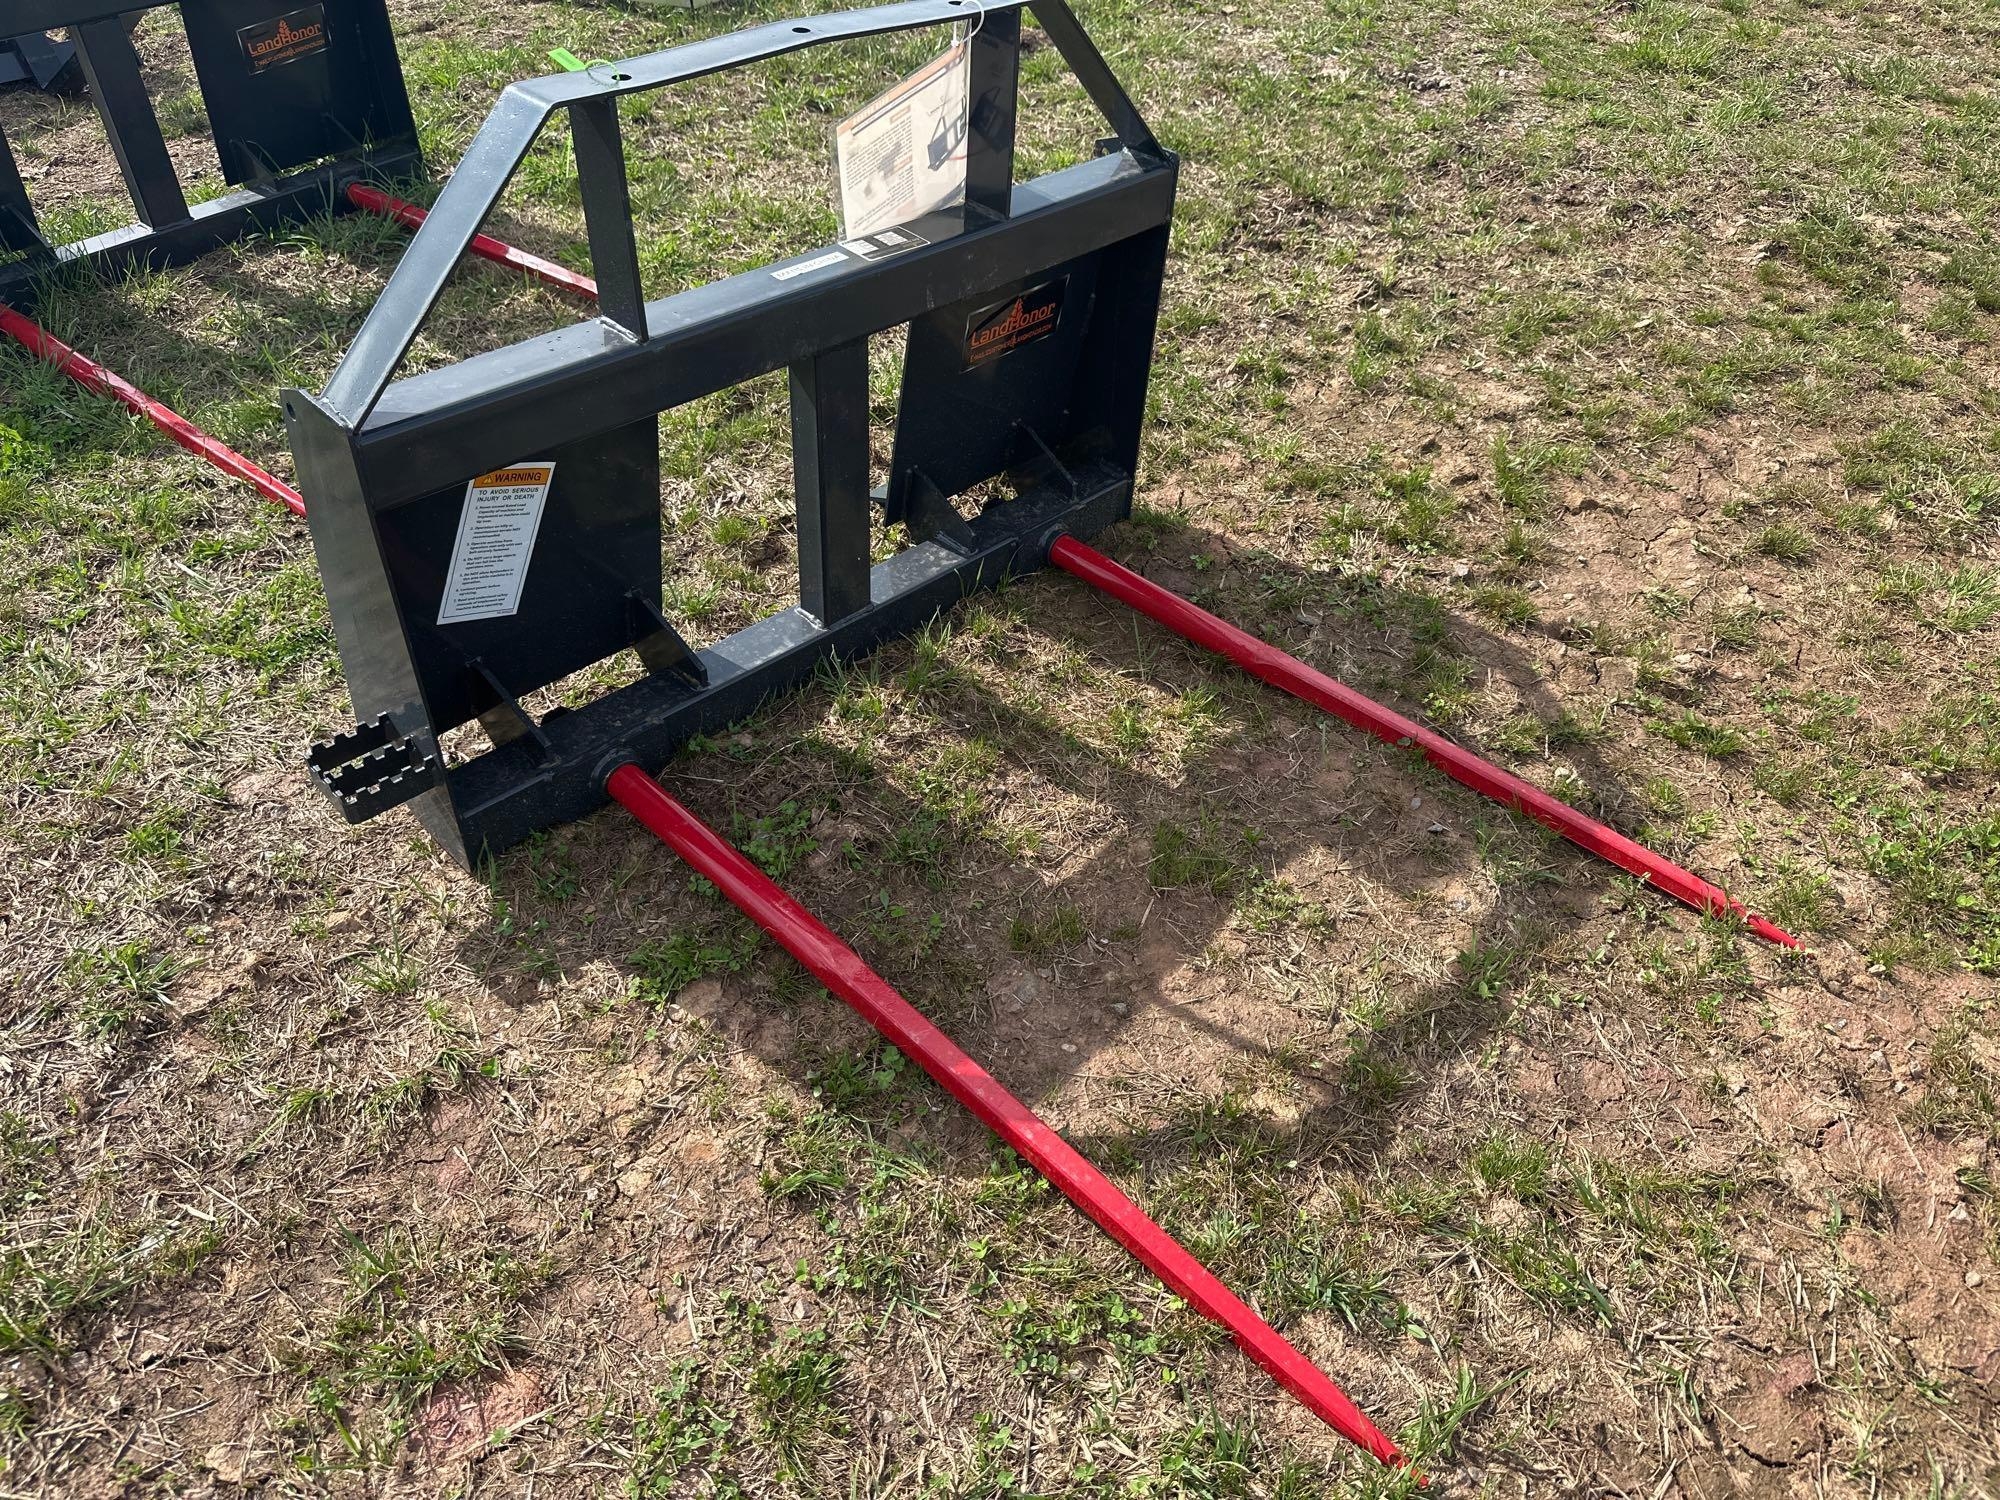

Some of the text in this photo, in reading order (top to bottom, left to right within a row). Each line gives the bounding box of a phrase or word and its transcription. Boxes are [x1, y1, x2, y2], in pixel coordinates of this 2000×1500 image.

[247, 22, 321, 56] LandHonor
[971, 302, 1056, 346] LandHonor
[494, 472, 542, 482] WARNING
